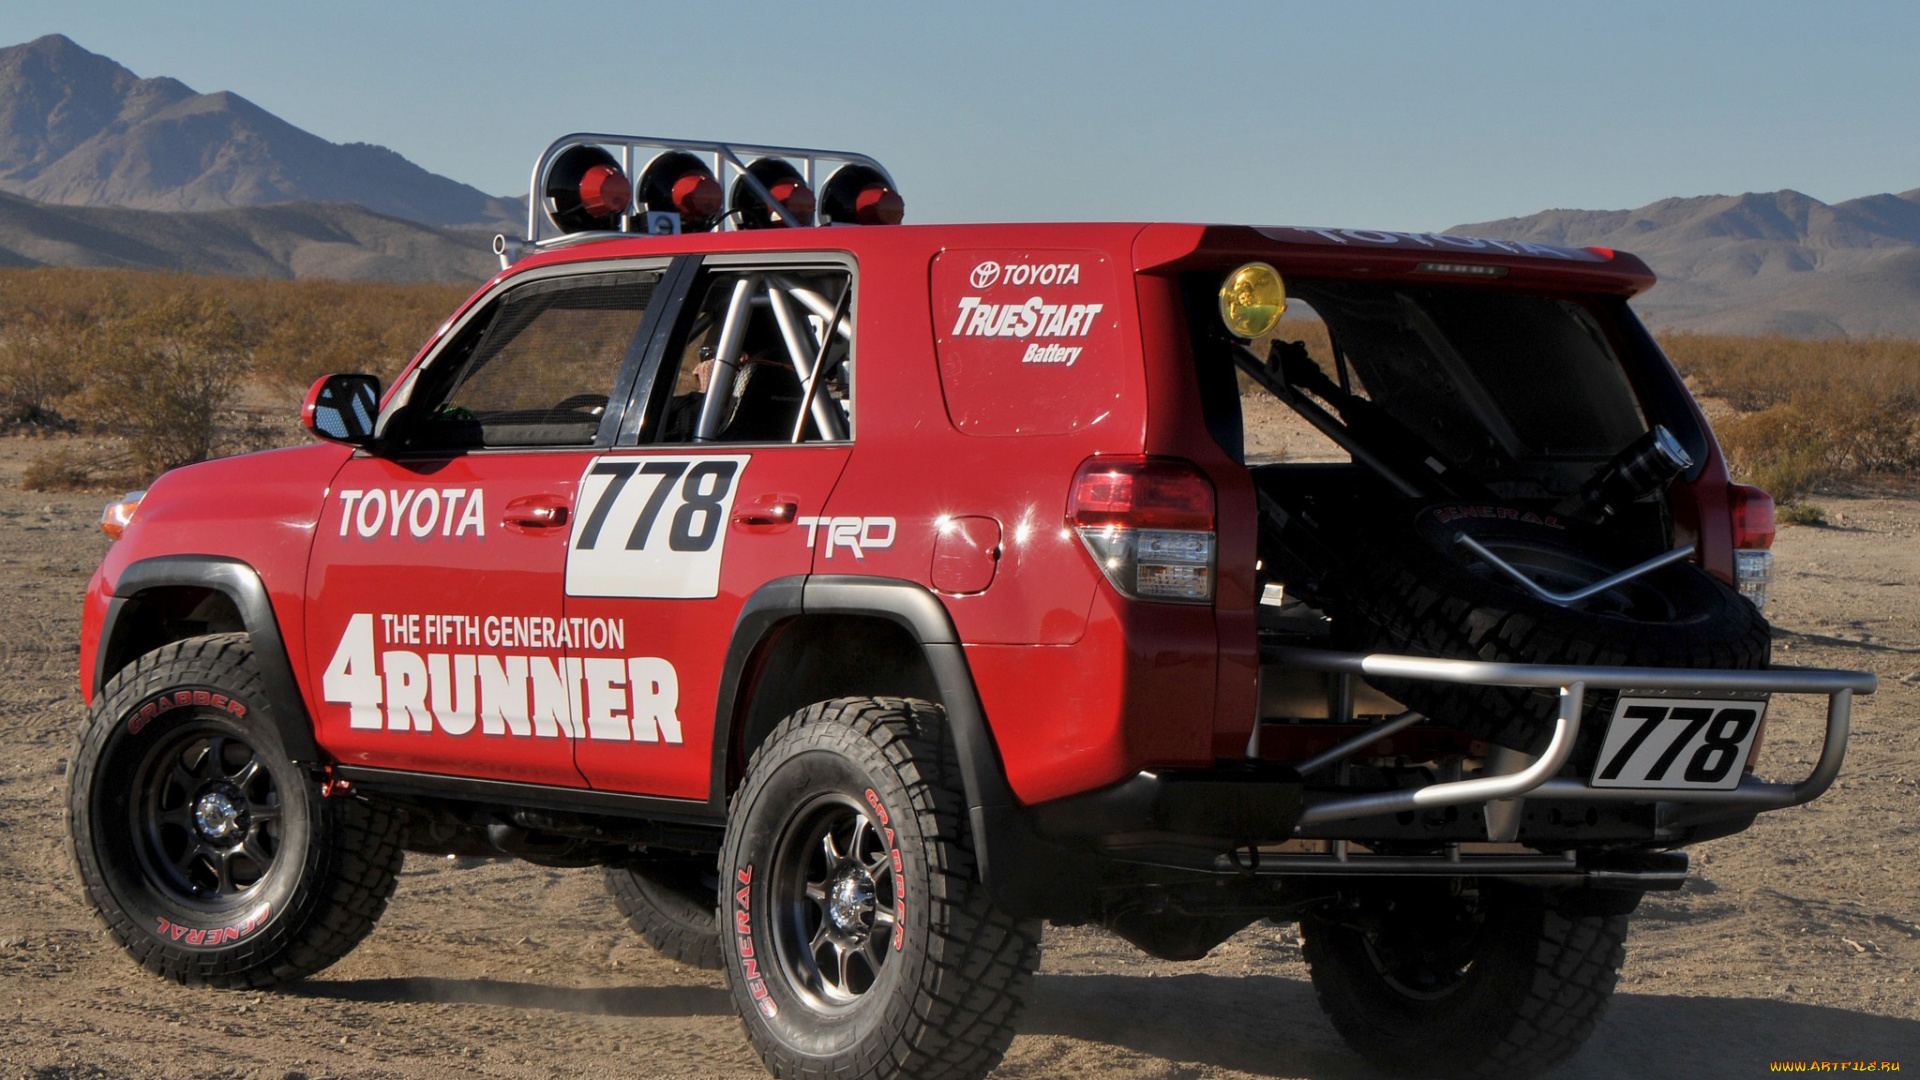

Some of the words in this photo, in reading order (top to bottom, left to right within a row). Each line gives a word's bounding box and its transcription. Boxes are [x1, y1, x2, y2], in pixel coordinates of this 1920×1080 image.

[1003, 264, 1080, 285] TOYOTA
[1022, 343, 1083, 367] Battery
[339, 488, 486, 537] TOYOTA
[575, 460, 740, 552] 778
[1433, 505, 1566, 530] GENERAL
[797, 516, 897, 559] TRD
[381, 614, 420, 645] THE
[425, 615, 480, 647] FIFTH
[484, 616, 625, 650] GENERATION
[126, 690, 248, 735] GRABBER
[1598, 705, 1757, 783] 778
[865, 788, 906, 952] GRABBER
[155, 901, 271, 945] GENERAL
[736, 863, 779, 1019] GENERAL
